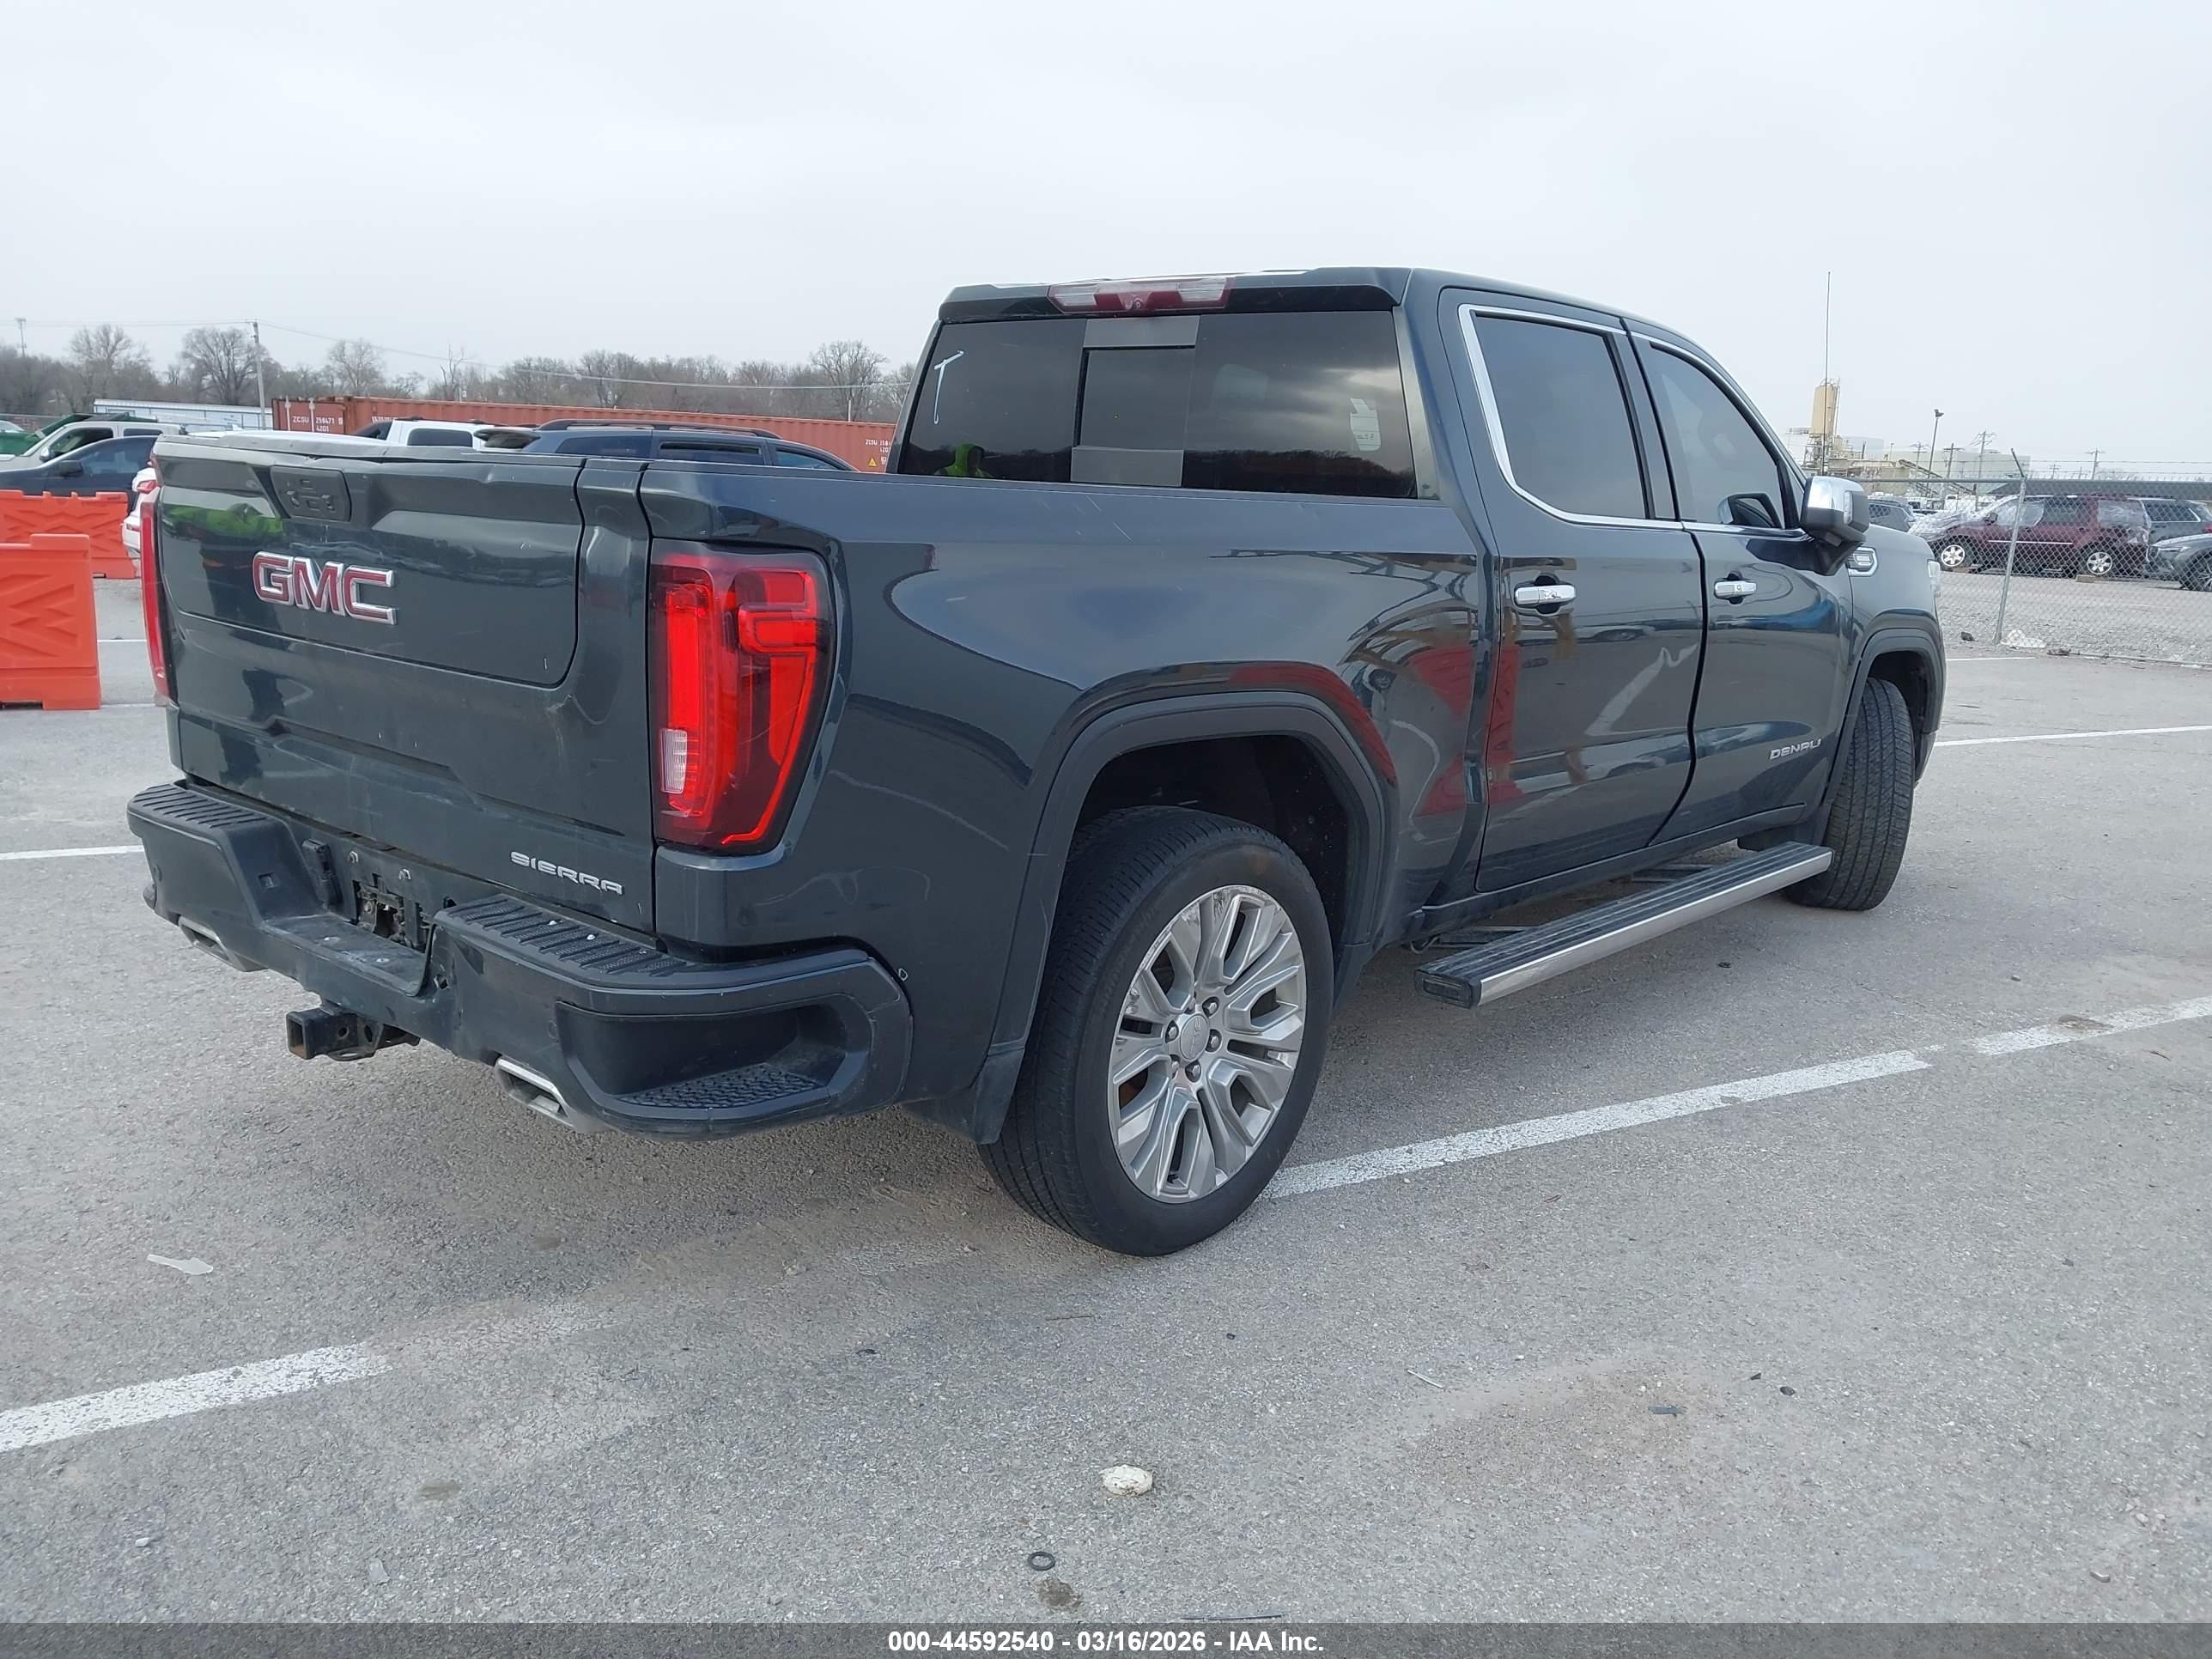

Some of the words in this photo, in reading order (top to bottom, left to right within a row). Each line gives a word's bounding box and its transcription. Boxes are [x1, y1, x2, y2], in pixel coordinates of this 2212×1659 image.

[252, 550, 397, 626] GMC
[1769, 738, 1821, 760] DENALI
[510, 851, 623, 895] SIERRA
